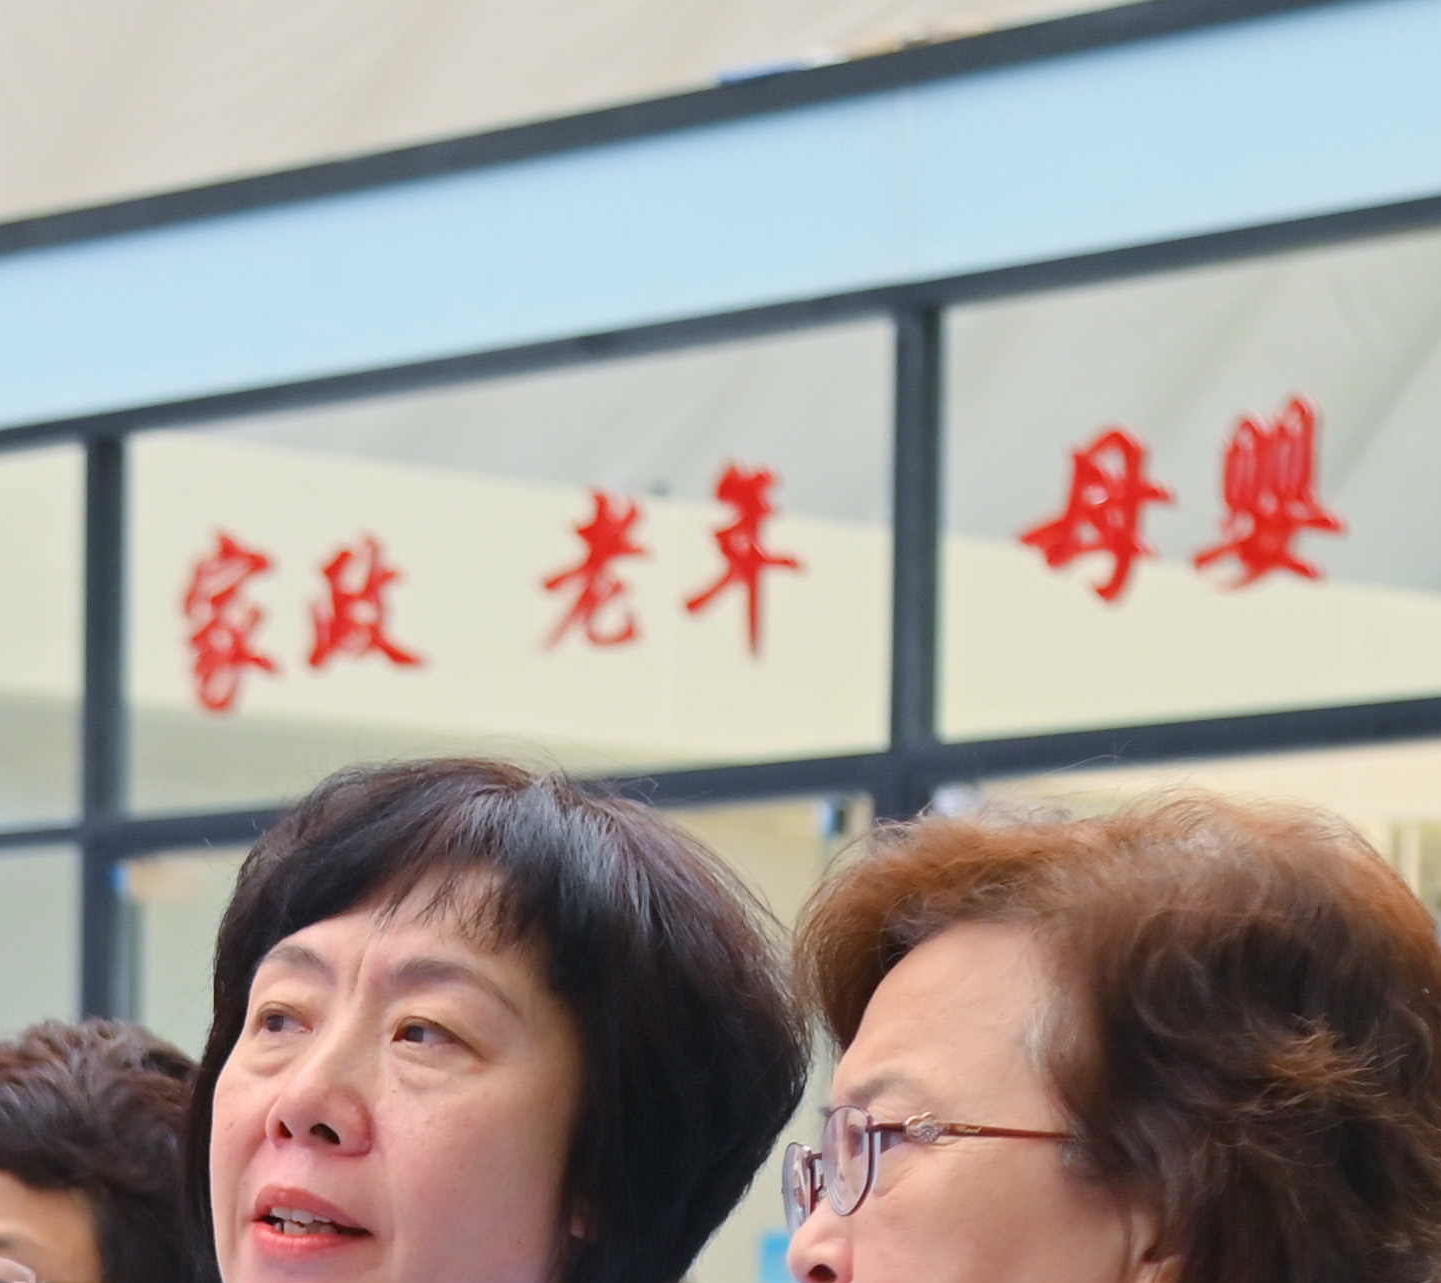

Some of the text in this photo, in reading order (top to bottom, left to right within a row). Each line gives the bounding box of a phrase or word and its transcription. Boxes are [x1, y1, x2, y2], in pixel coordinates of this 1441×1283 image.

[182, 530, 426, 714] 家政
[542, 460, 802, 650] 老年
[1018, 394, 1346, 604] 母婴
